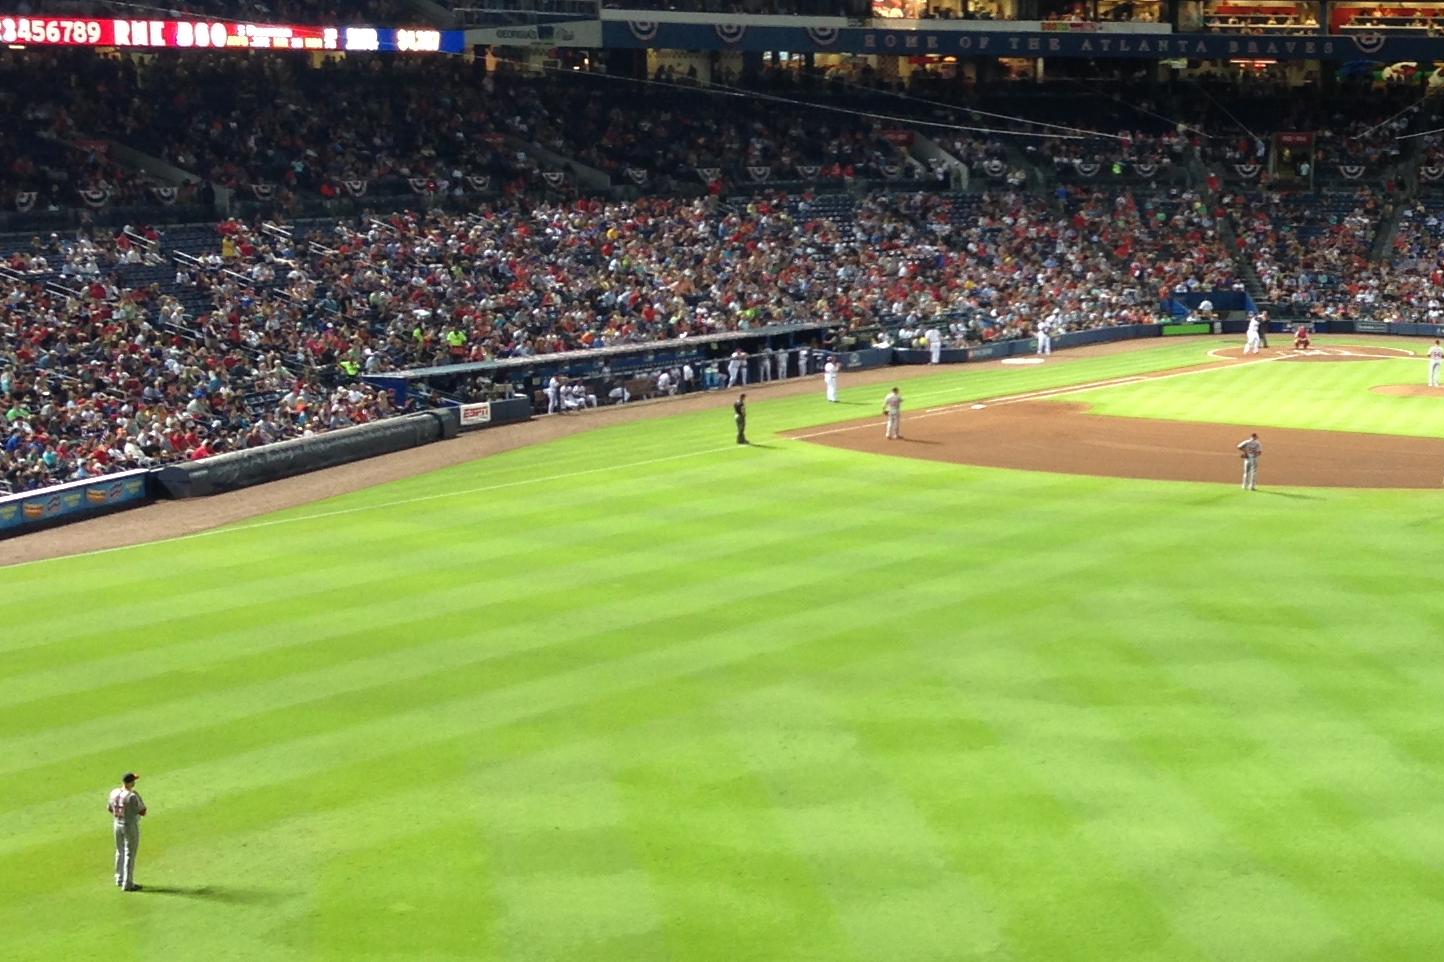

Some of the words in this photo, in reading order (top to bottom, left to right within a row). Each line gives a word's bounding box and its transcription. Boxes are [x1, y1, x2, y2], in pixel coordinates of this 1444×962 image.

[864, 34, 938, 48] HOME
[959, 36, 991, 50] OF
[1008, 37, 1061, 51] THE
[1081, 38, 1208, 53] ATLANTA
[1227, 41, 1335, 54] BRAVES
[463, 406, 489, 419] ESPN
